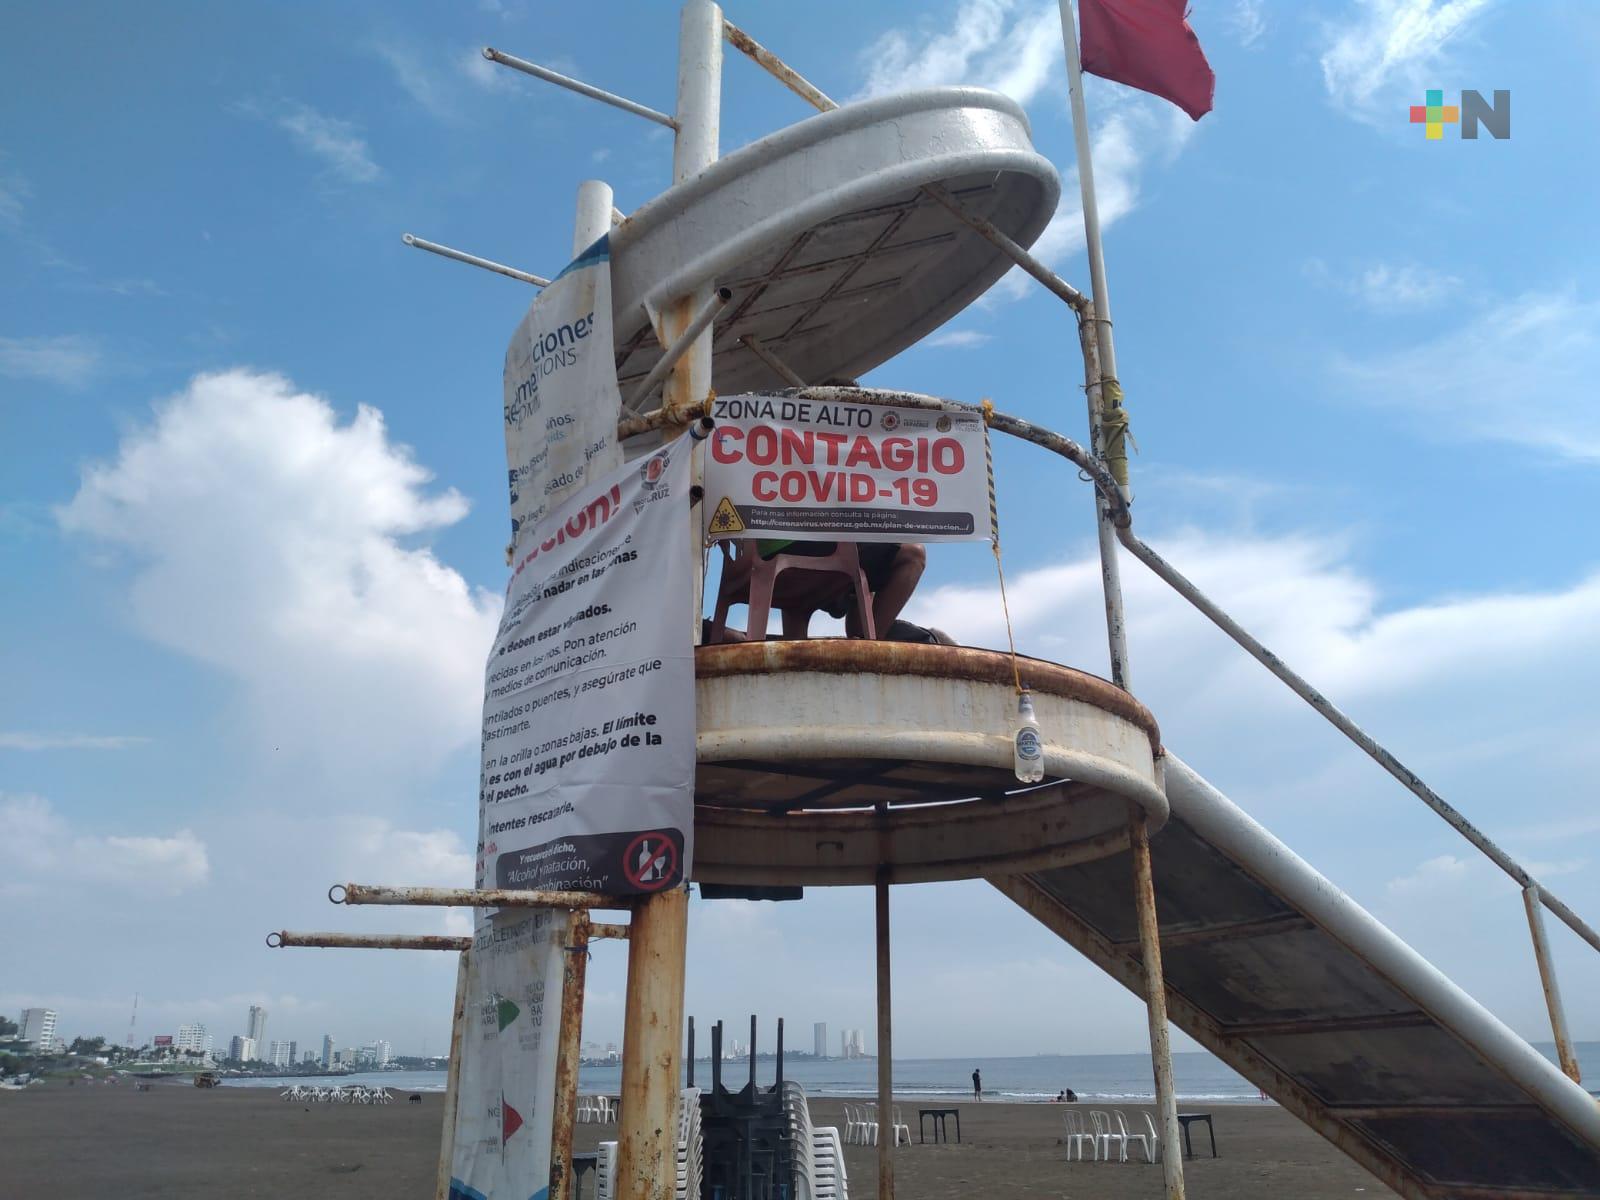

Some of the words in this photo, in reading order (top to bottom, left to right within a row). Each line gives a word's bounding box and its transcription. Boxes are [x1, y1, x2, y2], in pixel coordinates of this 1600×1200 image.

[714, 400, 776, 420] ZONA
[781, 403, 812, 423] DE
[816, 406, 873, 428] ALTO
[711, 425, 965, 474] CONTAGIO
[751, 470, 938, 507] COVID-19
[751, 508, 768, 516] Para
[543, 579, 576, 599] nadar
[577, 573, 589, 586] en
[591, 565, 606, 580] las
[507, 634, 536, 653] deben
[537, 624, 562, 642] estar
[520, 660, 532, 673] en
[563, 636, 586, 652] Pon
[588, 620, 637, 646] atención
[491, 679, 523, 699] medios
[524, 673, 534, 687] de
[535, 648, 607, 682] comunicación.
[524, 703, 531, 713] o
[532, 687, 571, 713] puentes,
[573, 684, 580, 699] y
[581, 668, 636, 692] asegúrate
[638, 659, 662, 676] que
[489, 774, 502, 785] es
[503, 769, 521, 782] con
[524, 763, 533, 777] el
[534, 756, 557, 775] agua
[559, 750, 576, 768] por
[578, 738, 617, 759] debajo
[620, 733, 641, 748] de
[646, 731, 662, 746] la
[499, 754, 508, 767] la
[511, 747, 532, 764] orilla
[534, 745, 540, 756] o
[540, 735, 569, 753] zonas
[569, 727, 599, 744] bajas.
[602, 720, 614, 735] El
[616, 712, 657, 731] límite
[496, 784, 529, 803] pecho.
